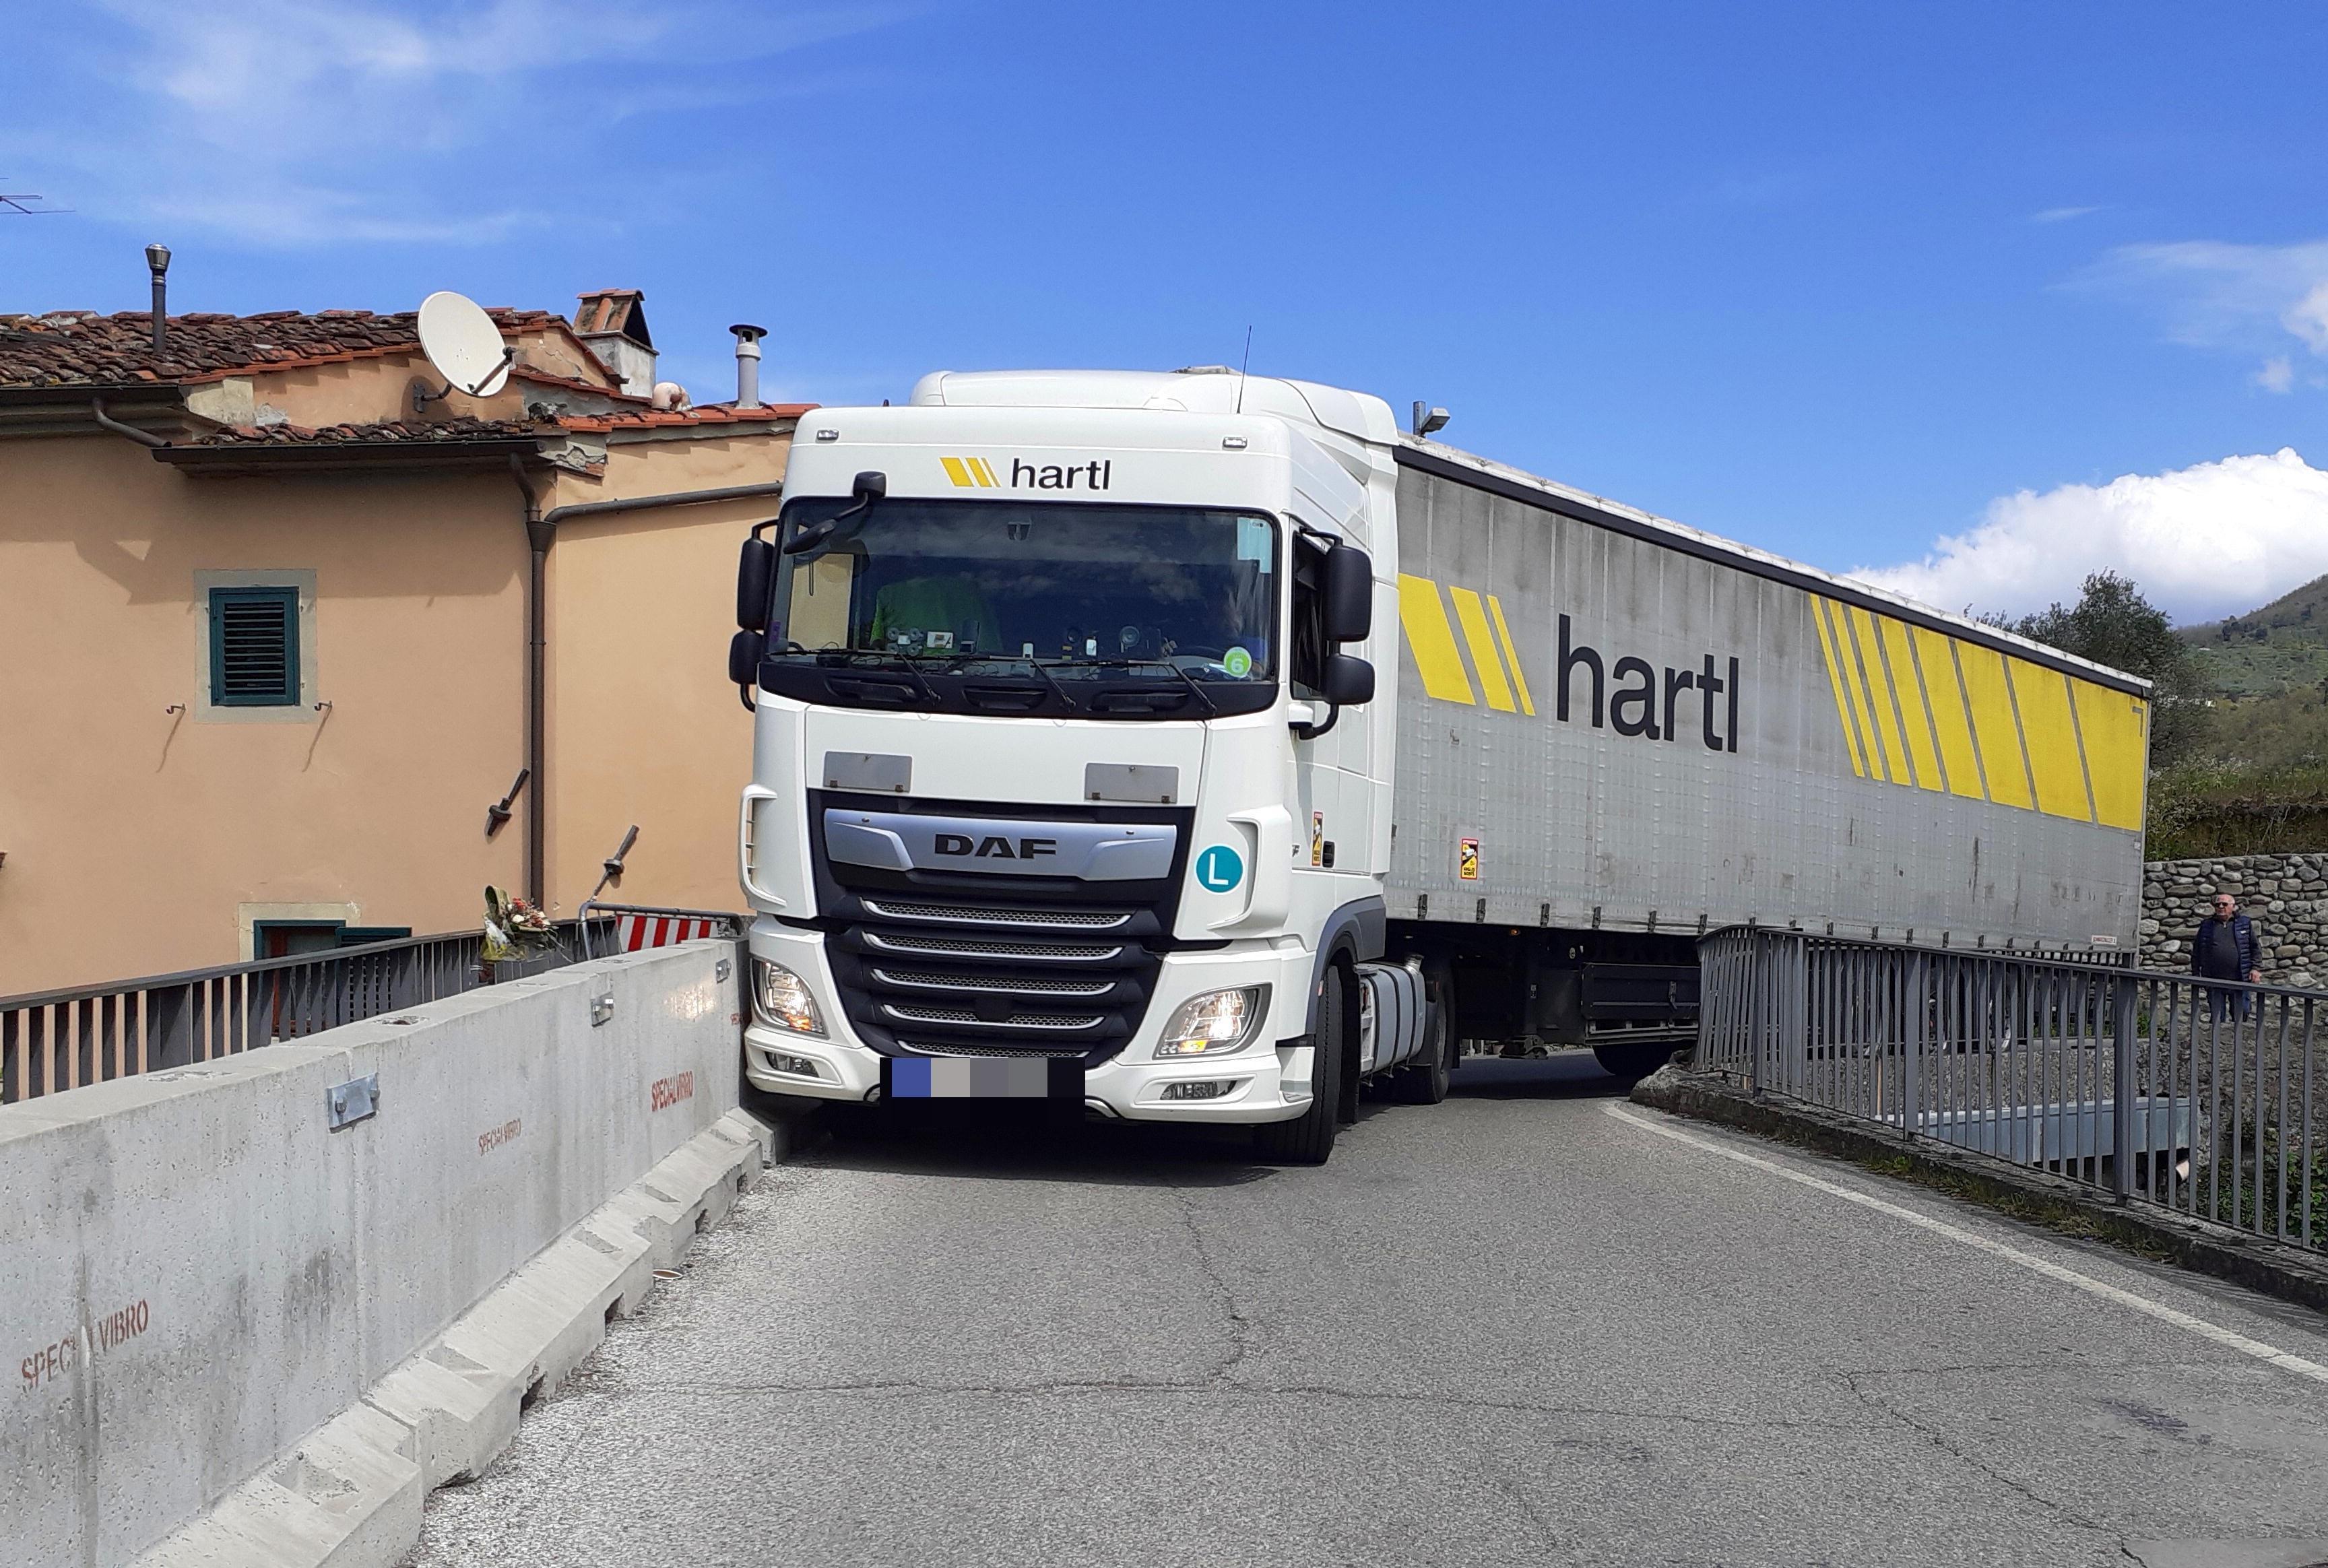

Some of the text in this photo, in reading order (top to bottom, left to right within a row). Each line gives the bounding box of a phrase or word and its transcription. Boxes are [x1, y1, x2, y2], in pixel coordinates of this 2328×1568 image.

[1012, 458, 1111, 490] hartl
[1557, 613, 1739, 754] hartl
[934, 833, 1057, 859] DAF
[1208, 853, 1229, 886] L
